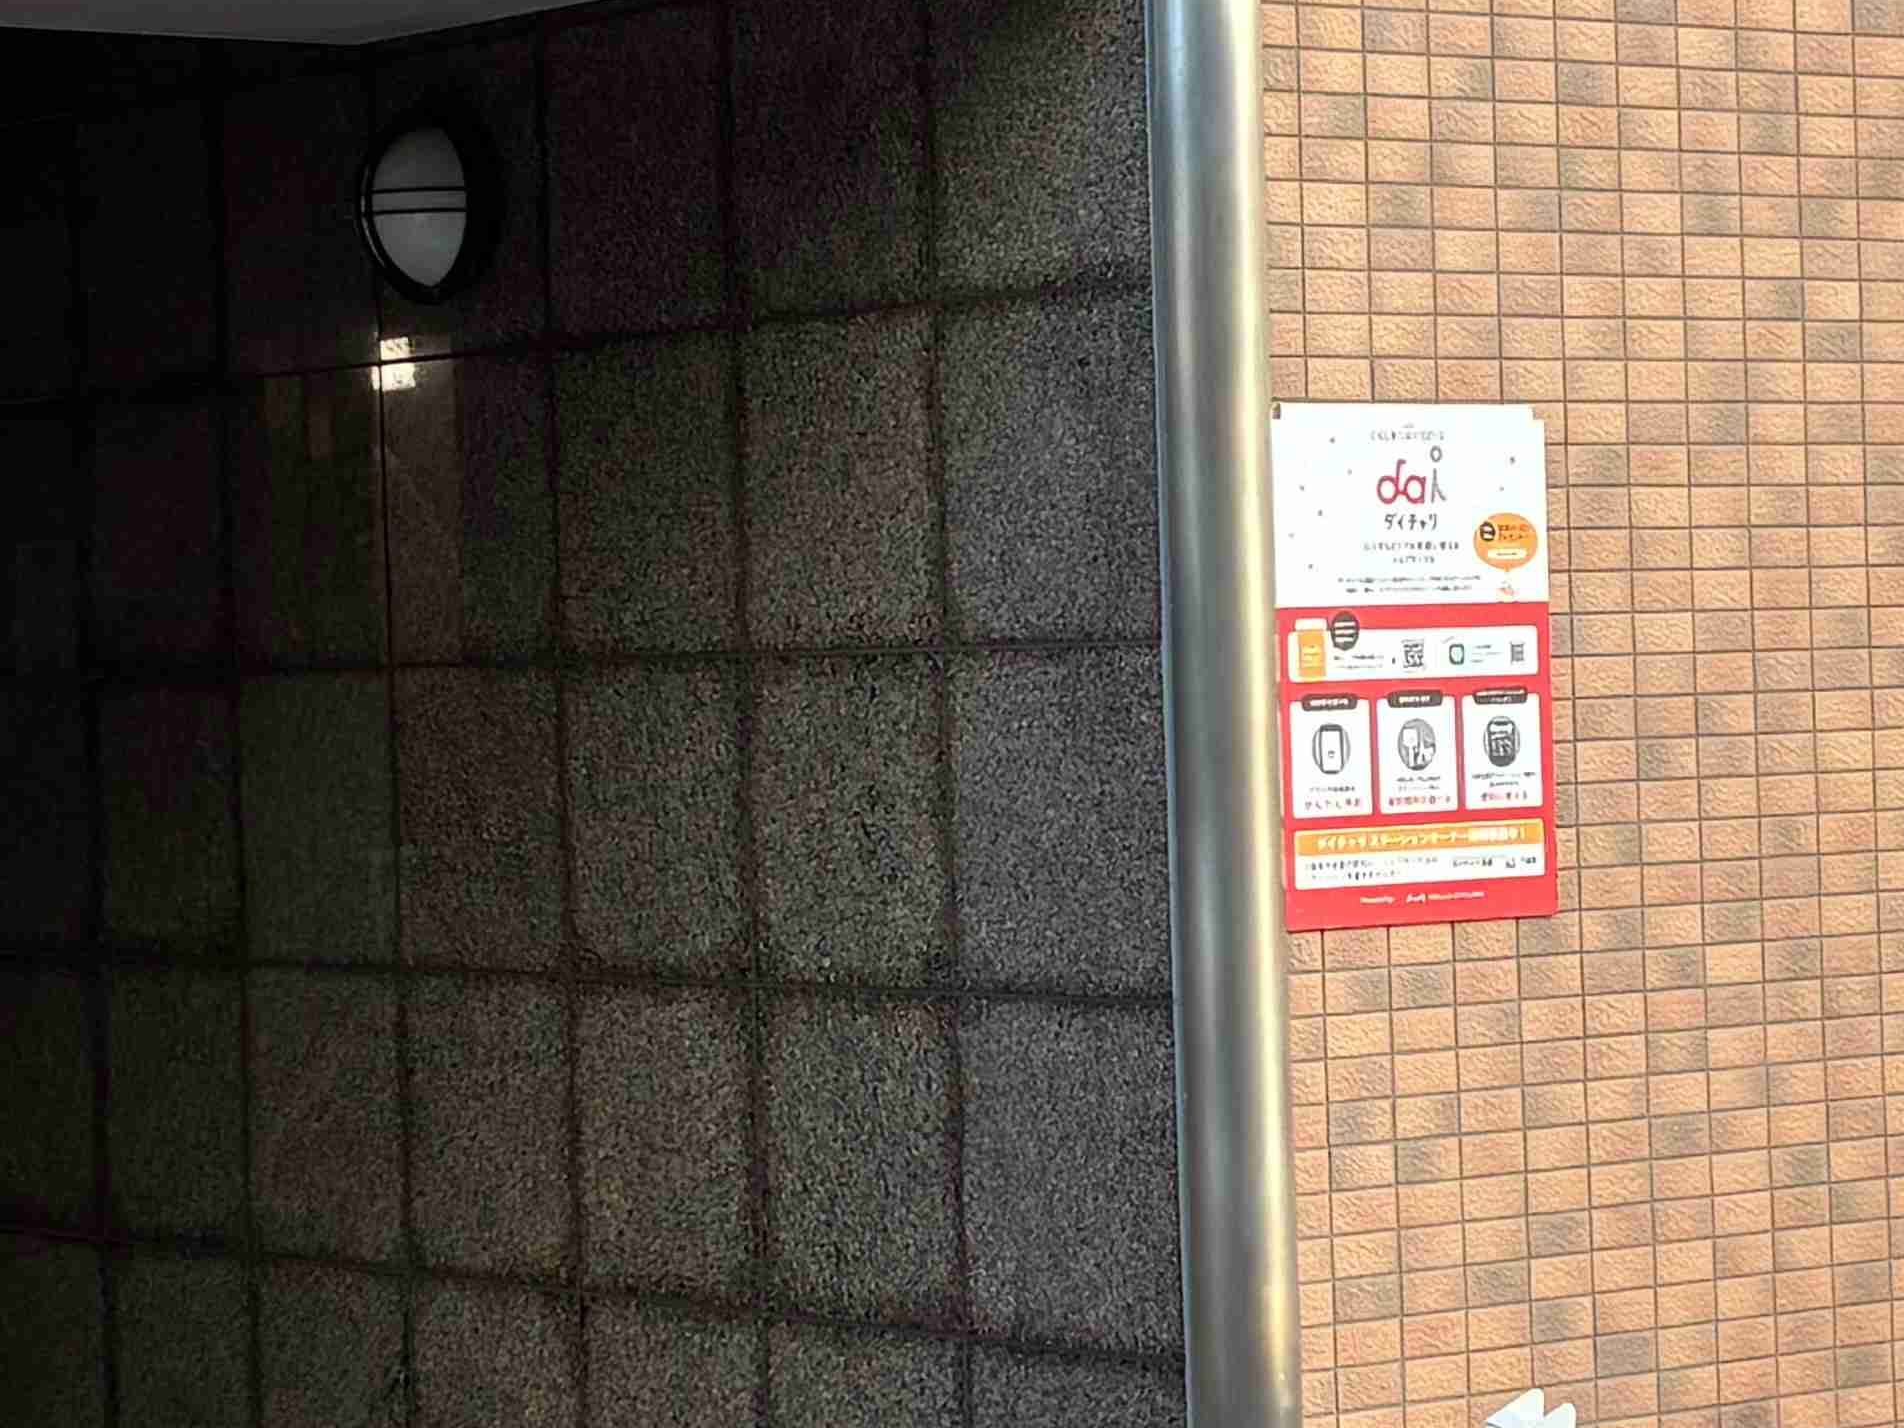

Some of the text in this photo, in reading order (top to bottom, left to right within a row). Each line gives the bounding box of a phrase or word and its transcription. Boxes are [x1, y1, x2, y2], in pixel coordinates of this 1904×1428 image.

[1383, 512, 1439, 531] ダイチャリ
